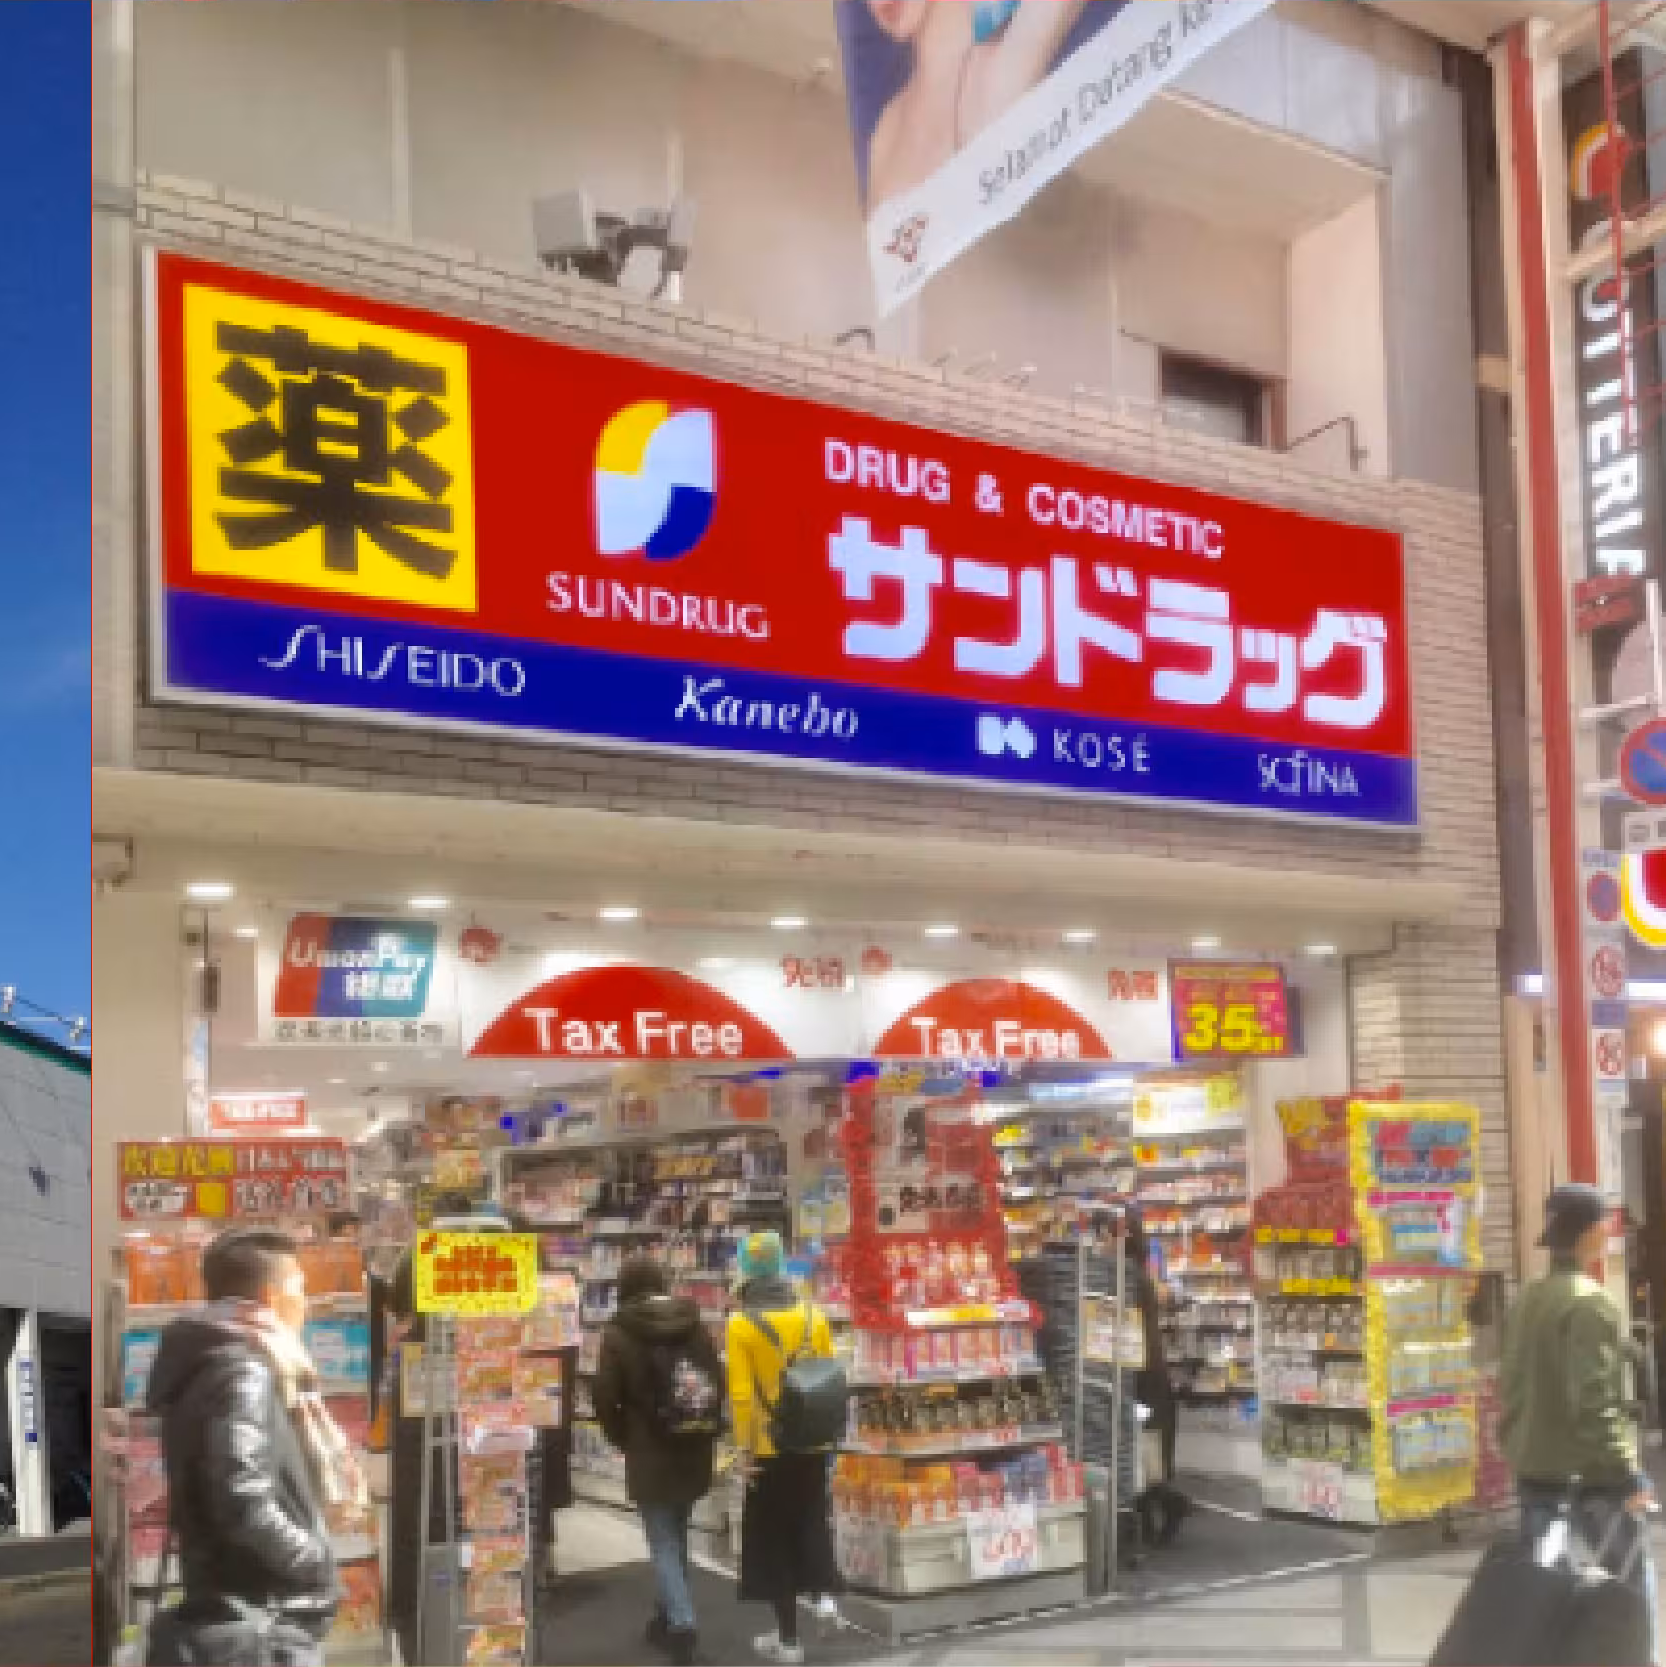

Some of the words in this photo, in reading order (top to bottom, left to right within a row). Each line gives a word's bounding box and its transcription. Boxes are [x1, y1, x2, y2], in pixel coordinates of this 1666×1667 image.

[213, 320, 458, 581] 薬
[824, 437, 950, 502] DRUG
[975, 473, 1004, 513] &
[1026, 482, 1225, 560] COSMETIC
[546, 570, 770, 639] SUNDRUG
[827, 516, 1389, 730] サンドラッグ
[259, 624, 526, 697] SHISEIDO
[675, 675, 859, 738] Kanebo
[525, 1008, 622, 1052] Tax
[636, 1010, 744, 1054] Free
[911, 1016, 982, 1058] Tax
[995, 1019, 1081, 1058] Free
